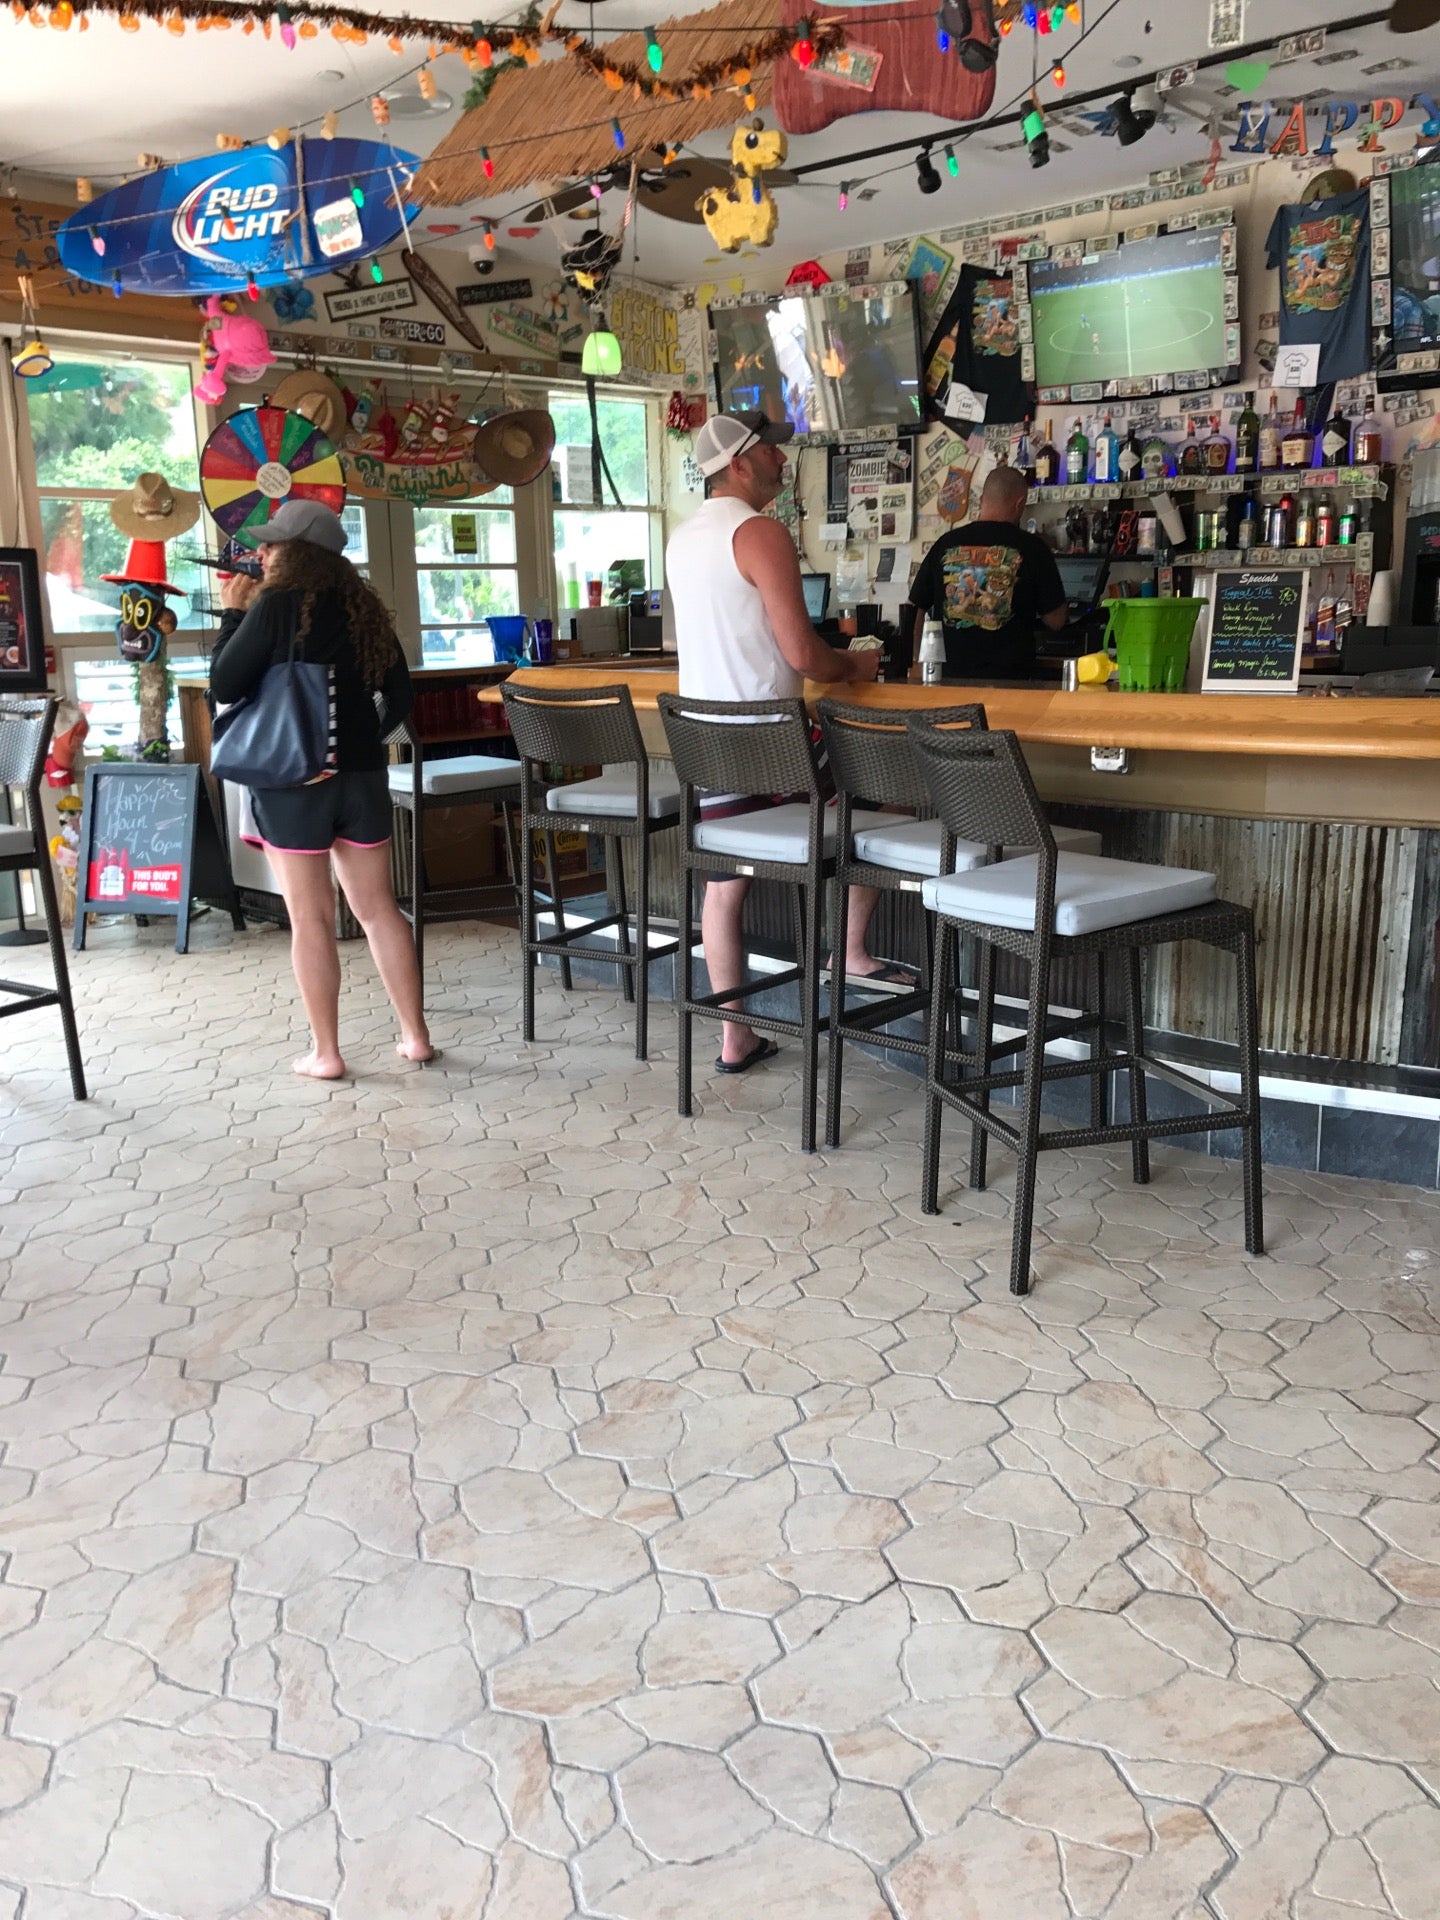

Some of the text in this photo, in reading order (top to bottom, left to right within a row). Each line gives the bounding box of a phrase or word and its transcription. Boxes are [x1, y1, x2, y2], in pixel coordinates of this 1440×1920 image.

[205, 183, 278, 216] BUD
[192, 208, 290, 246] LIGHT
[850, 461, 886, 478] ZOMBIE
[1239, 573, 1279, 585] Specials
[104, 781, 161, 816] Happy
[132, 870, 178, 881] THIS BUD'S
[132, 881, 169, 892] FOR YOU.
